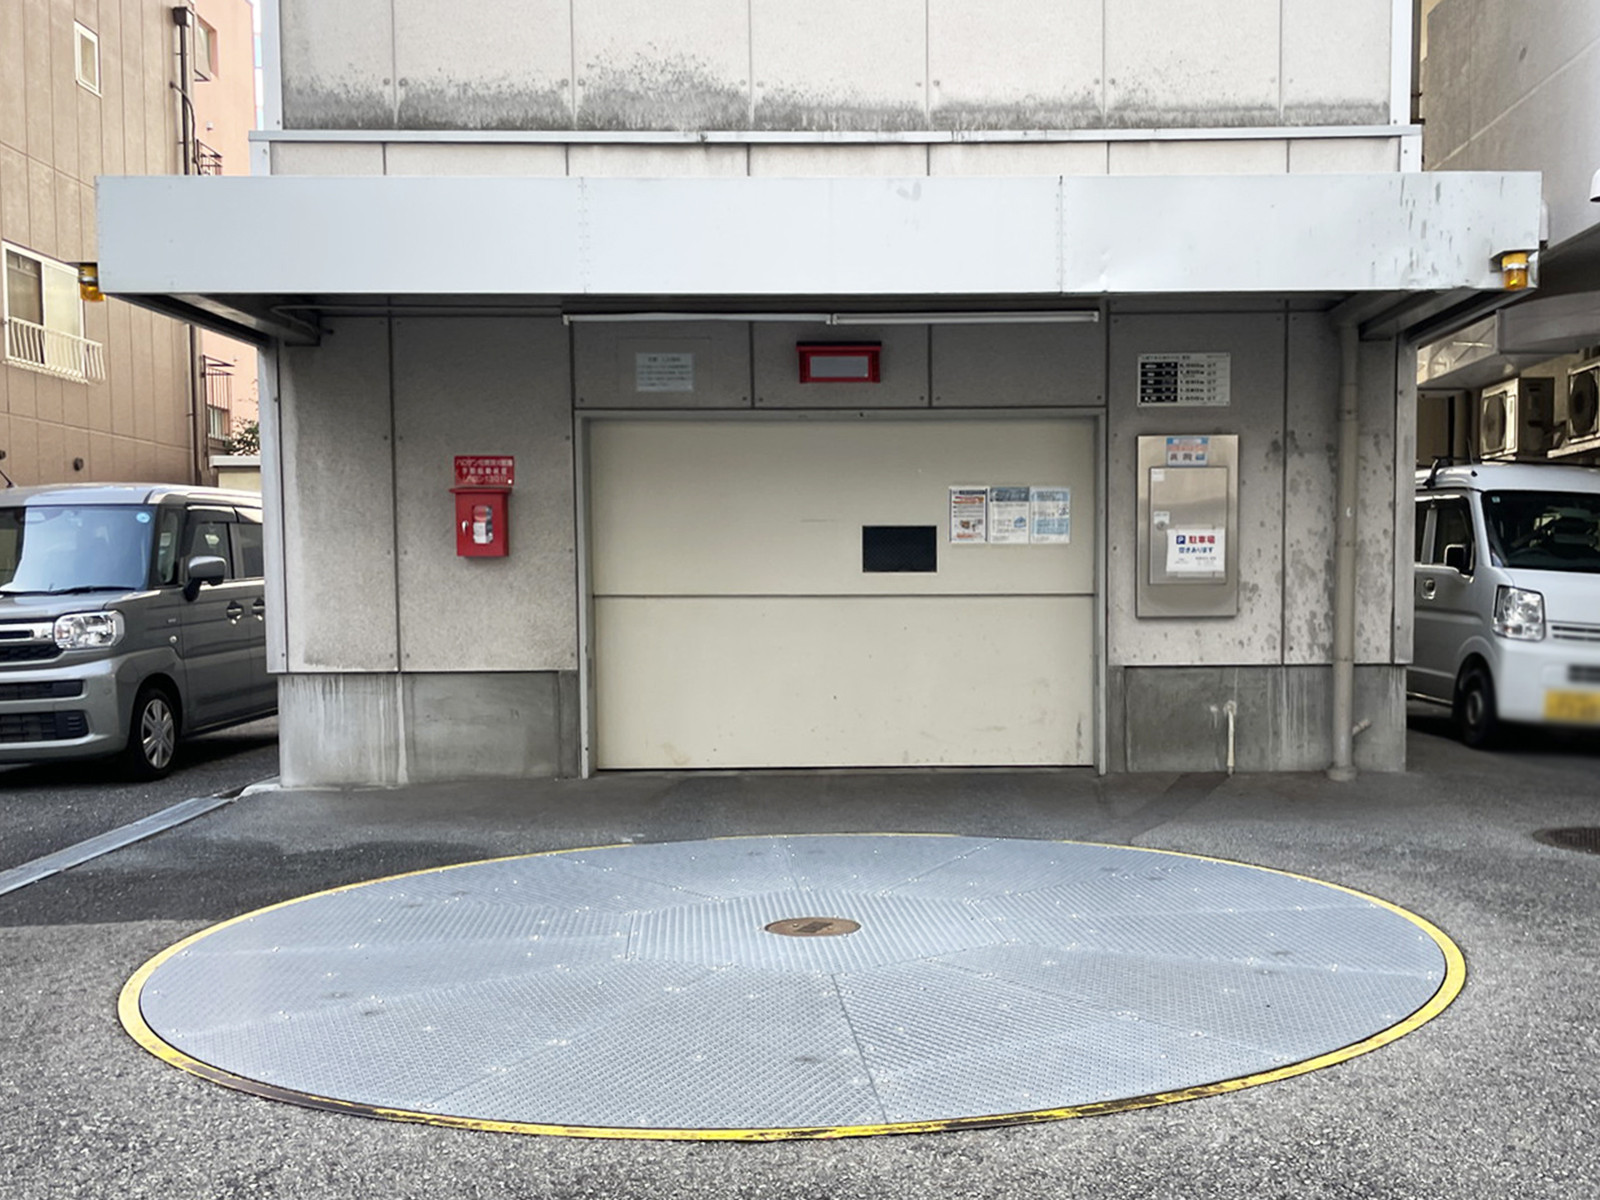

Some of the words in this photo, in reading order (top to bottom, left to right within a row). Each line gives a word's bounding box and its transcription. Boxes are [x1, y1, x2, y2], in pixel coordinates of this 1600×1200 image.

[1177, 535, 1185, 544] P
[1189, 535, 1215, 544] 駐車場
